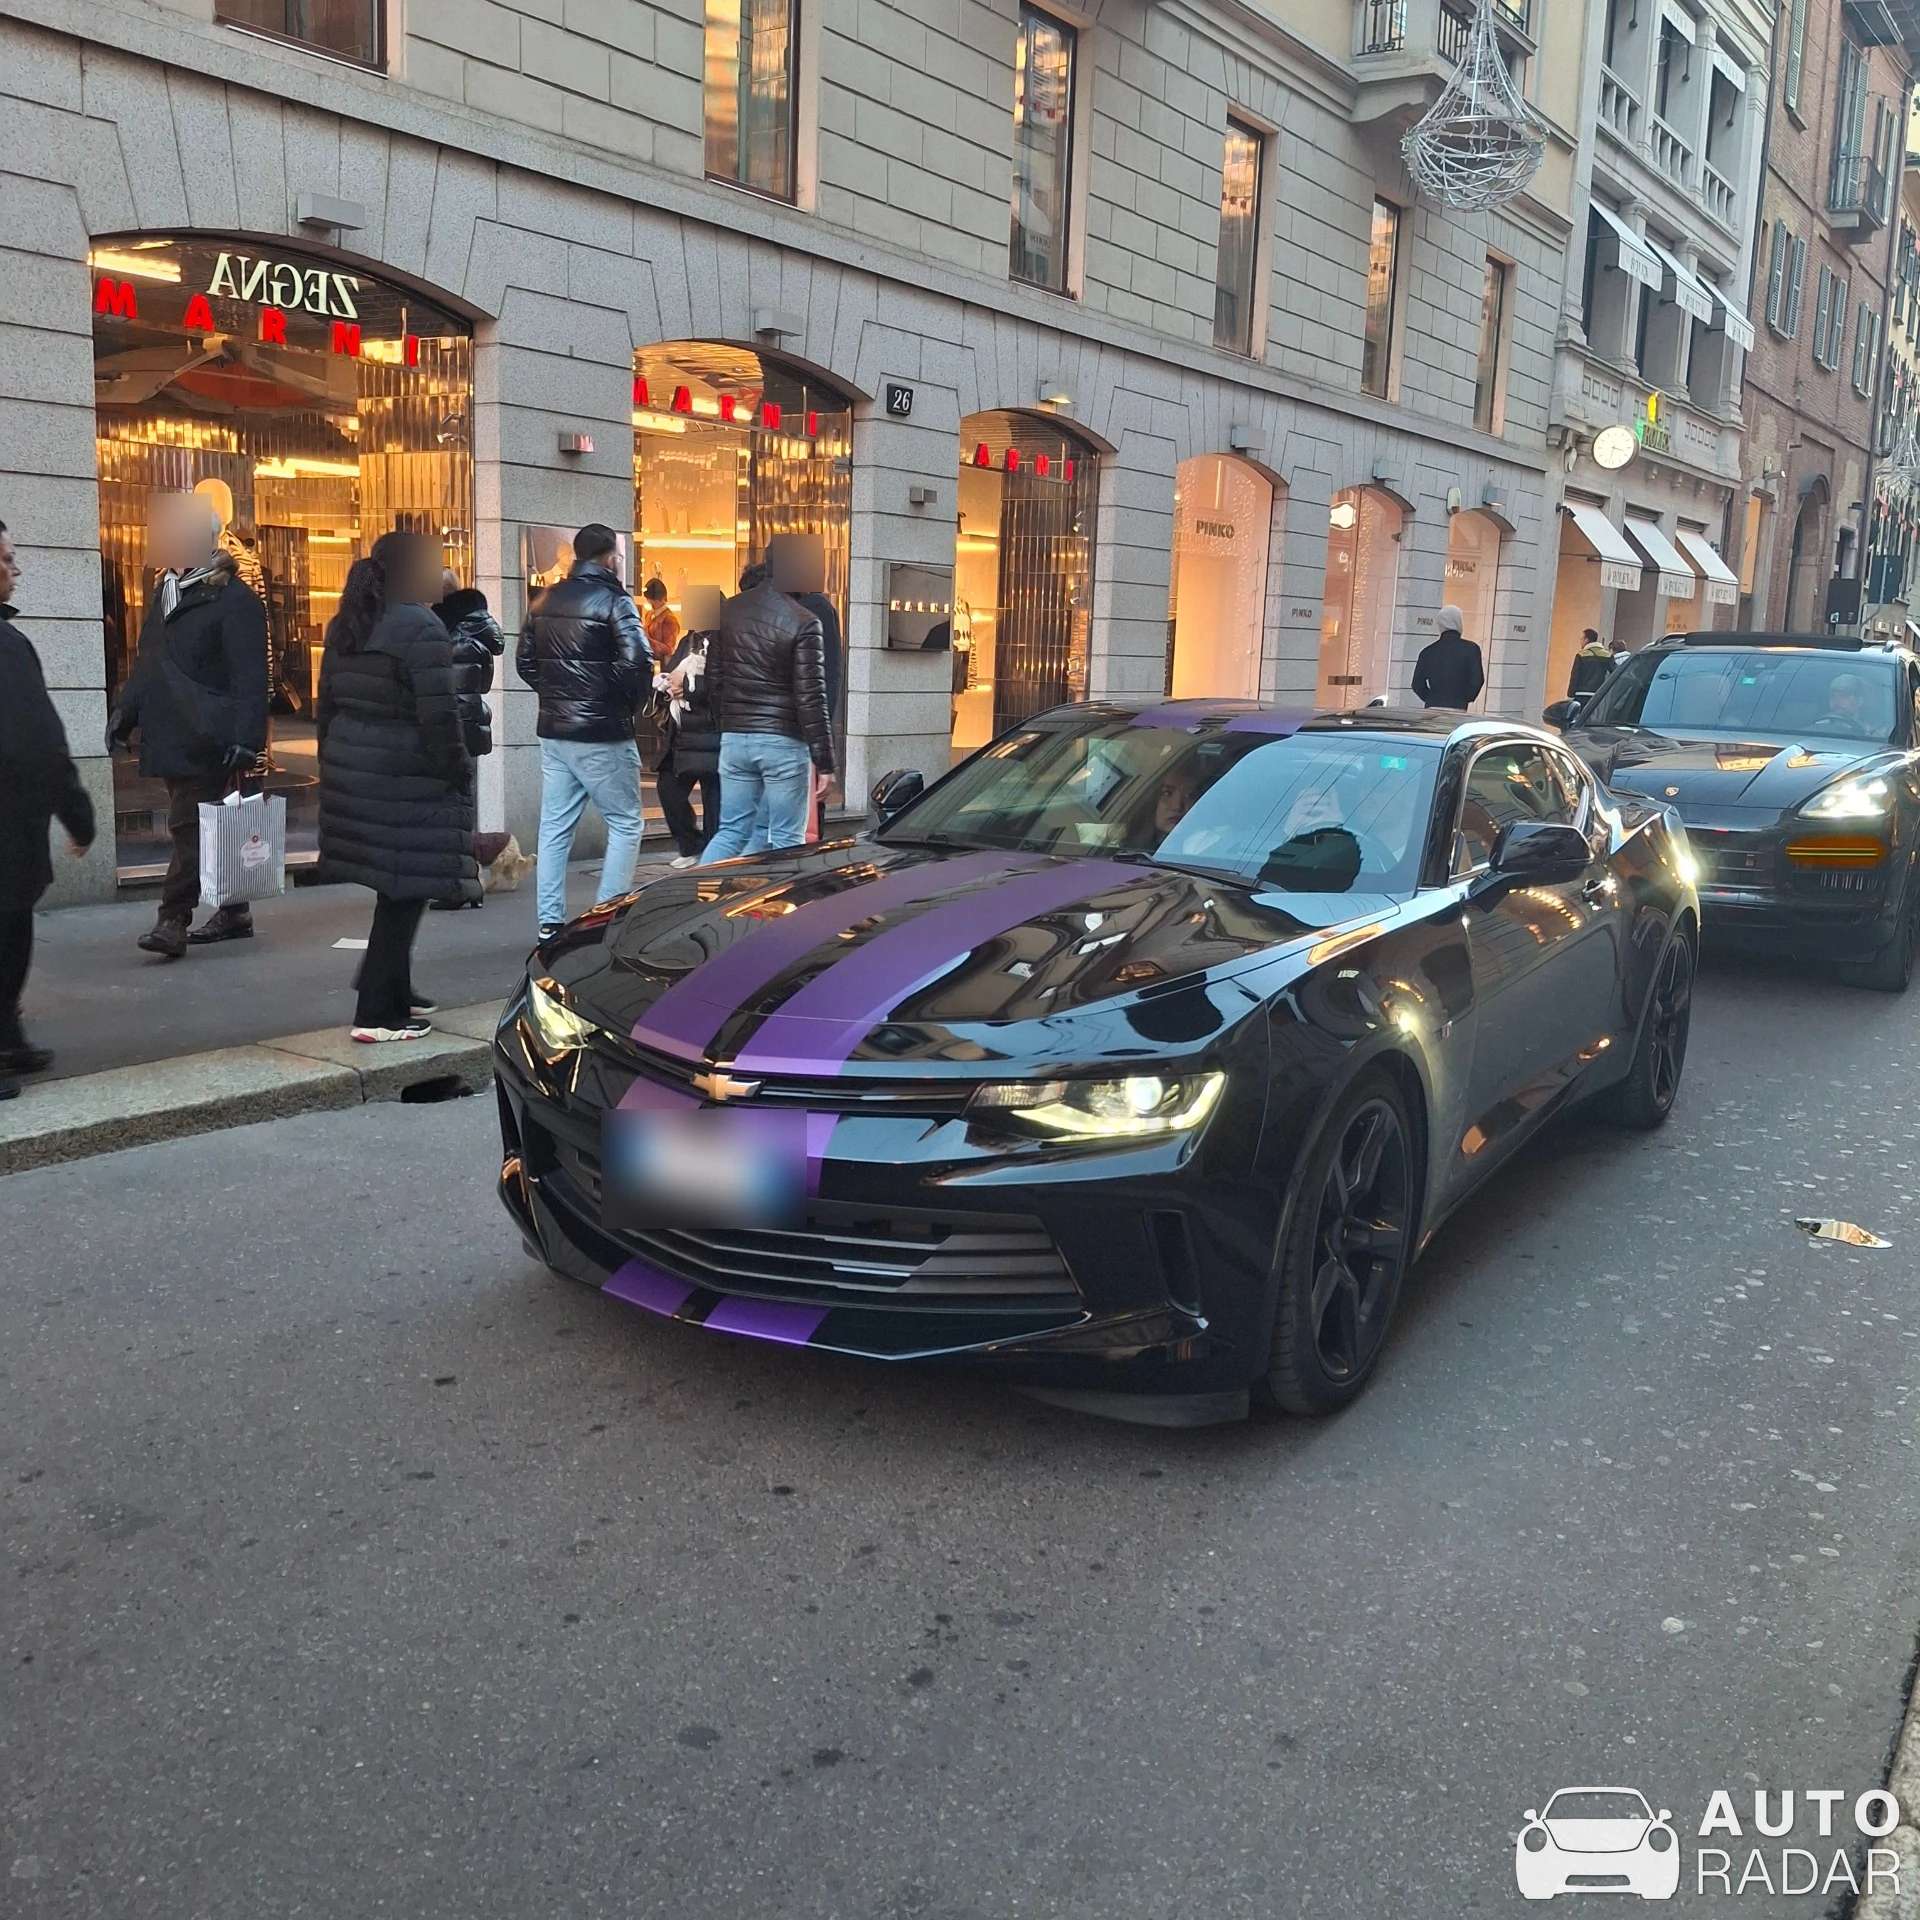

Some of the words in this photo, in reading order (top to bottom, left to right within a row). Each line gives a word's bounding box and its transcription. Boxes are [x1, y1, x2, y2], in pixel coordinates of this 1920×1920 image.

[96, 277, 419, 367] MARNI
[634, 376, 817, 437] MARNI
[894, 389, 911, 412] 26
[974, 443, 1073, 482] ARNI
[1196, 520, 1236, 539] PINKO
[1291, 608, 1312, 618] PINKO
